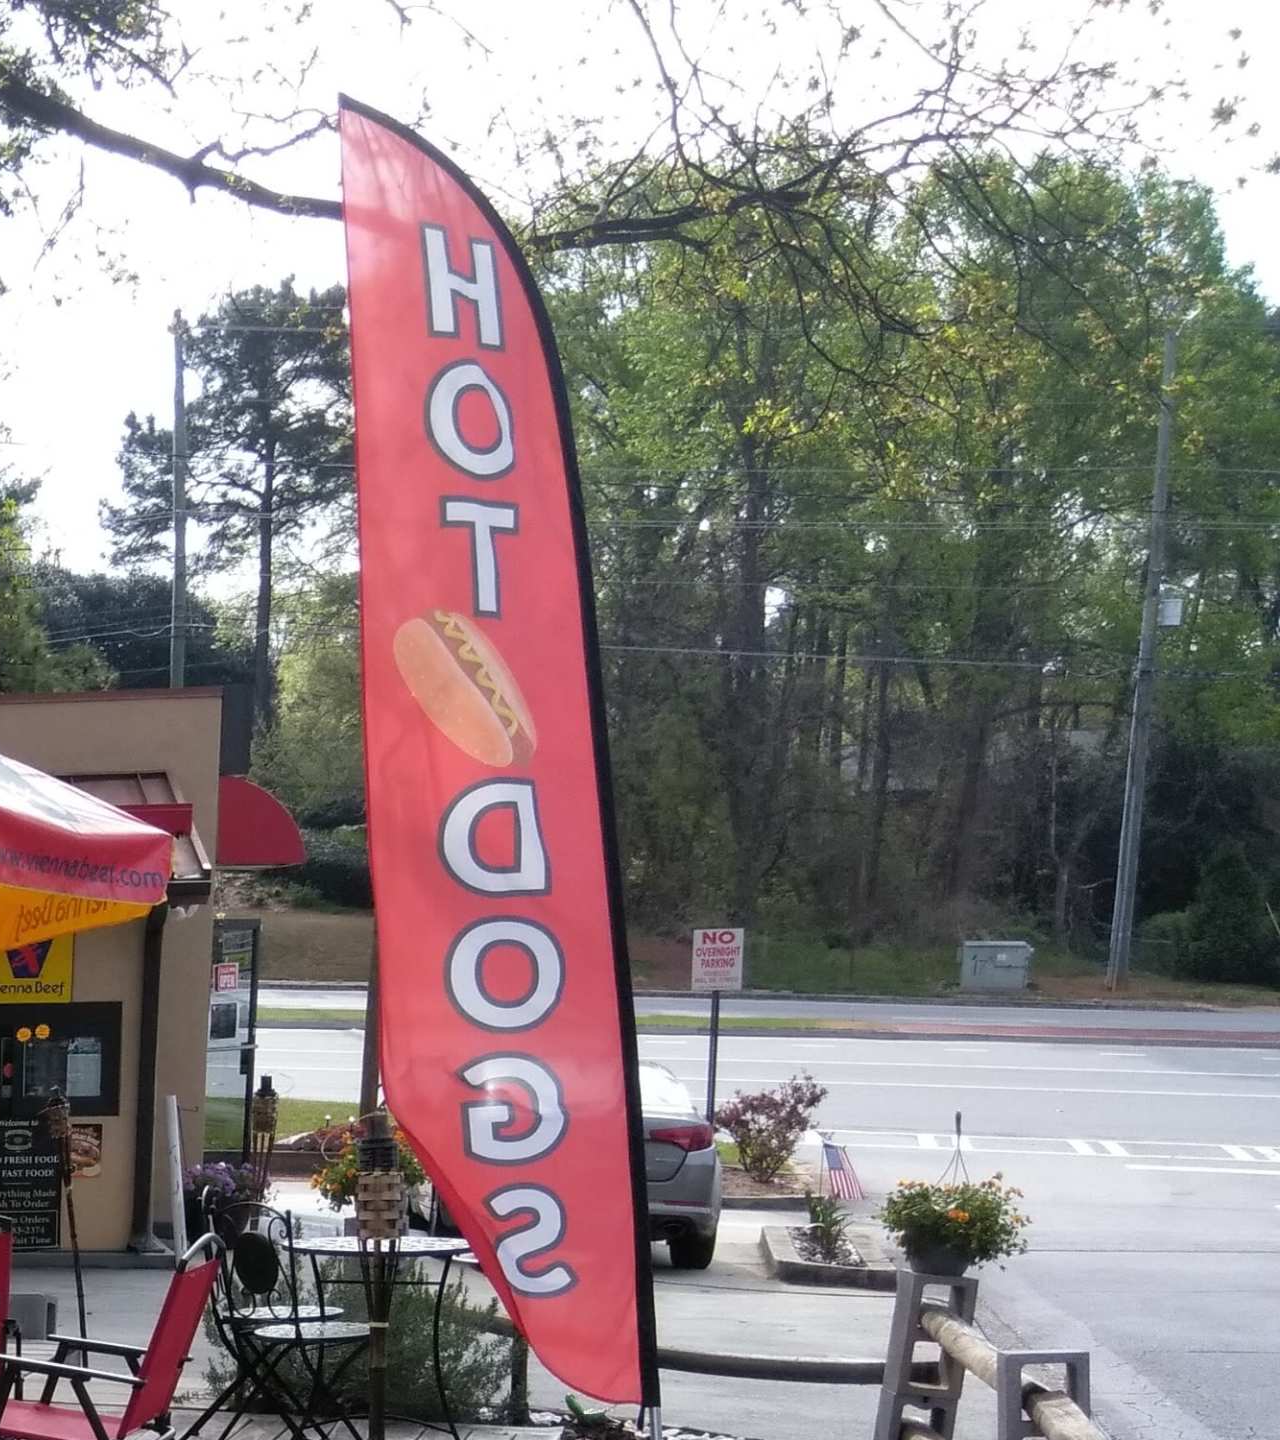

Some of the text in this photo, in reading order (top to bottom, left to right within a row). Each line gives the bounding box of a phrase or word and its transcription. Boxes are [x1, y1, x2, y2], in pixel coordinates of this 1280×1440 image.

[702, 931, 736, 944] NO
[695, 946, 740, 958] OVERNIGHT
[700, 957, 736, 969] PARKING
[35, 982, 65, 996] Beef
[4, 1156, 32, 1164] FRESH
[2, 1169, 24, 1178] FAST
[33, 1189, 57, 1198] Made
[23, 1199, 49, 1208] Order
